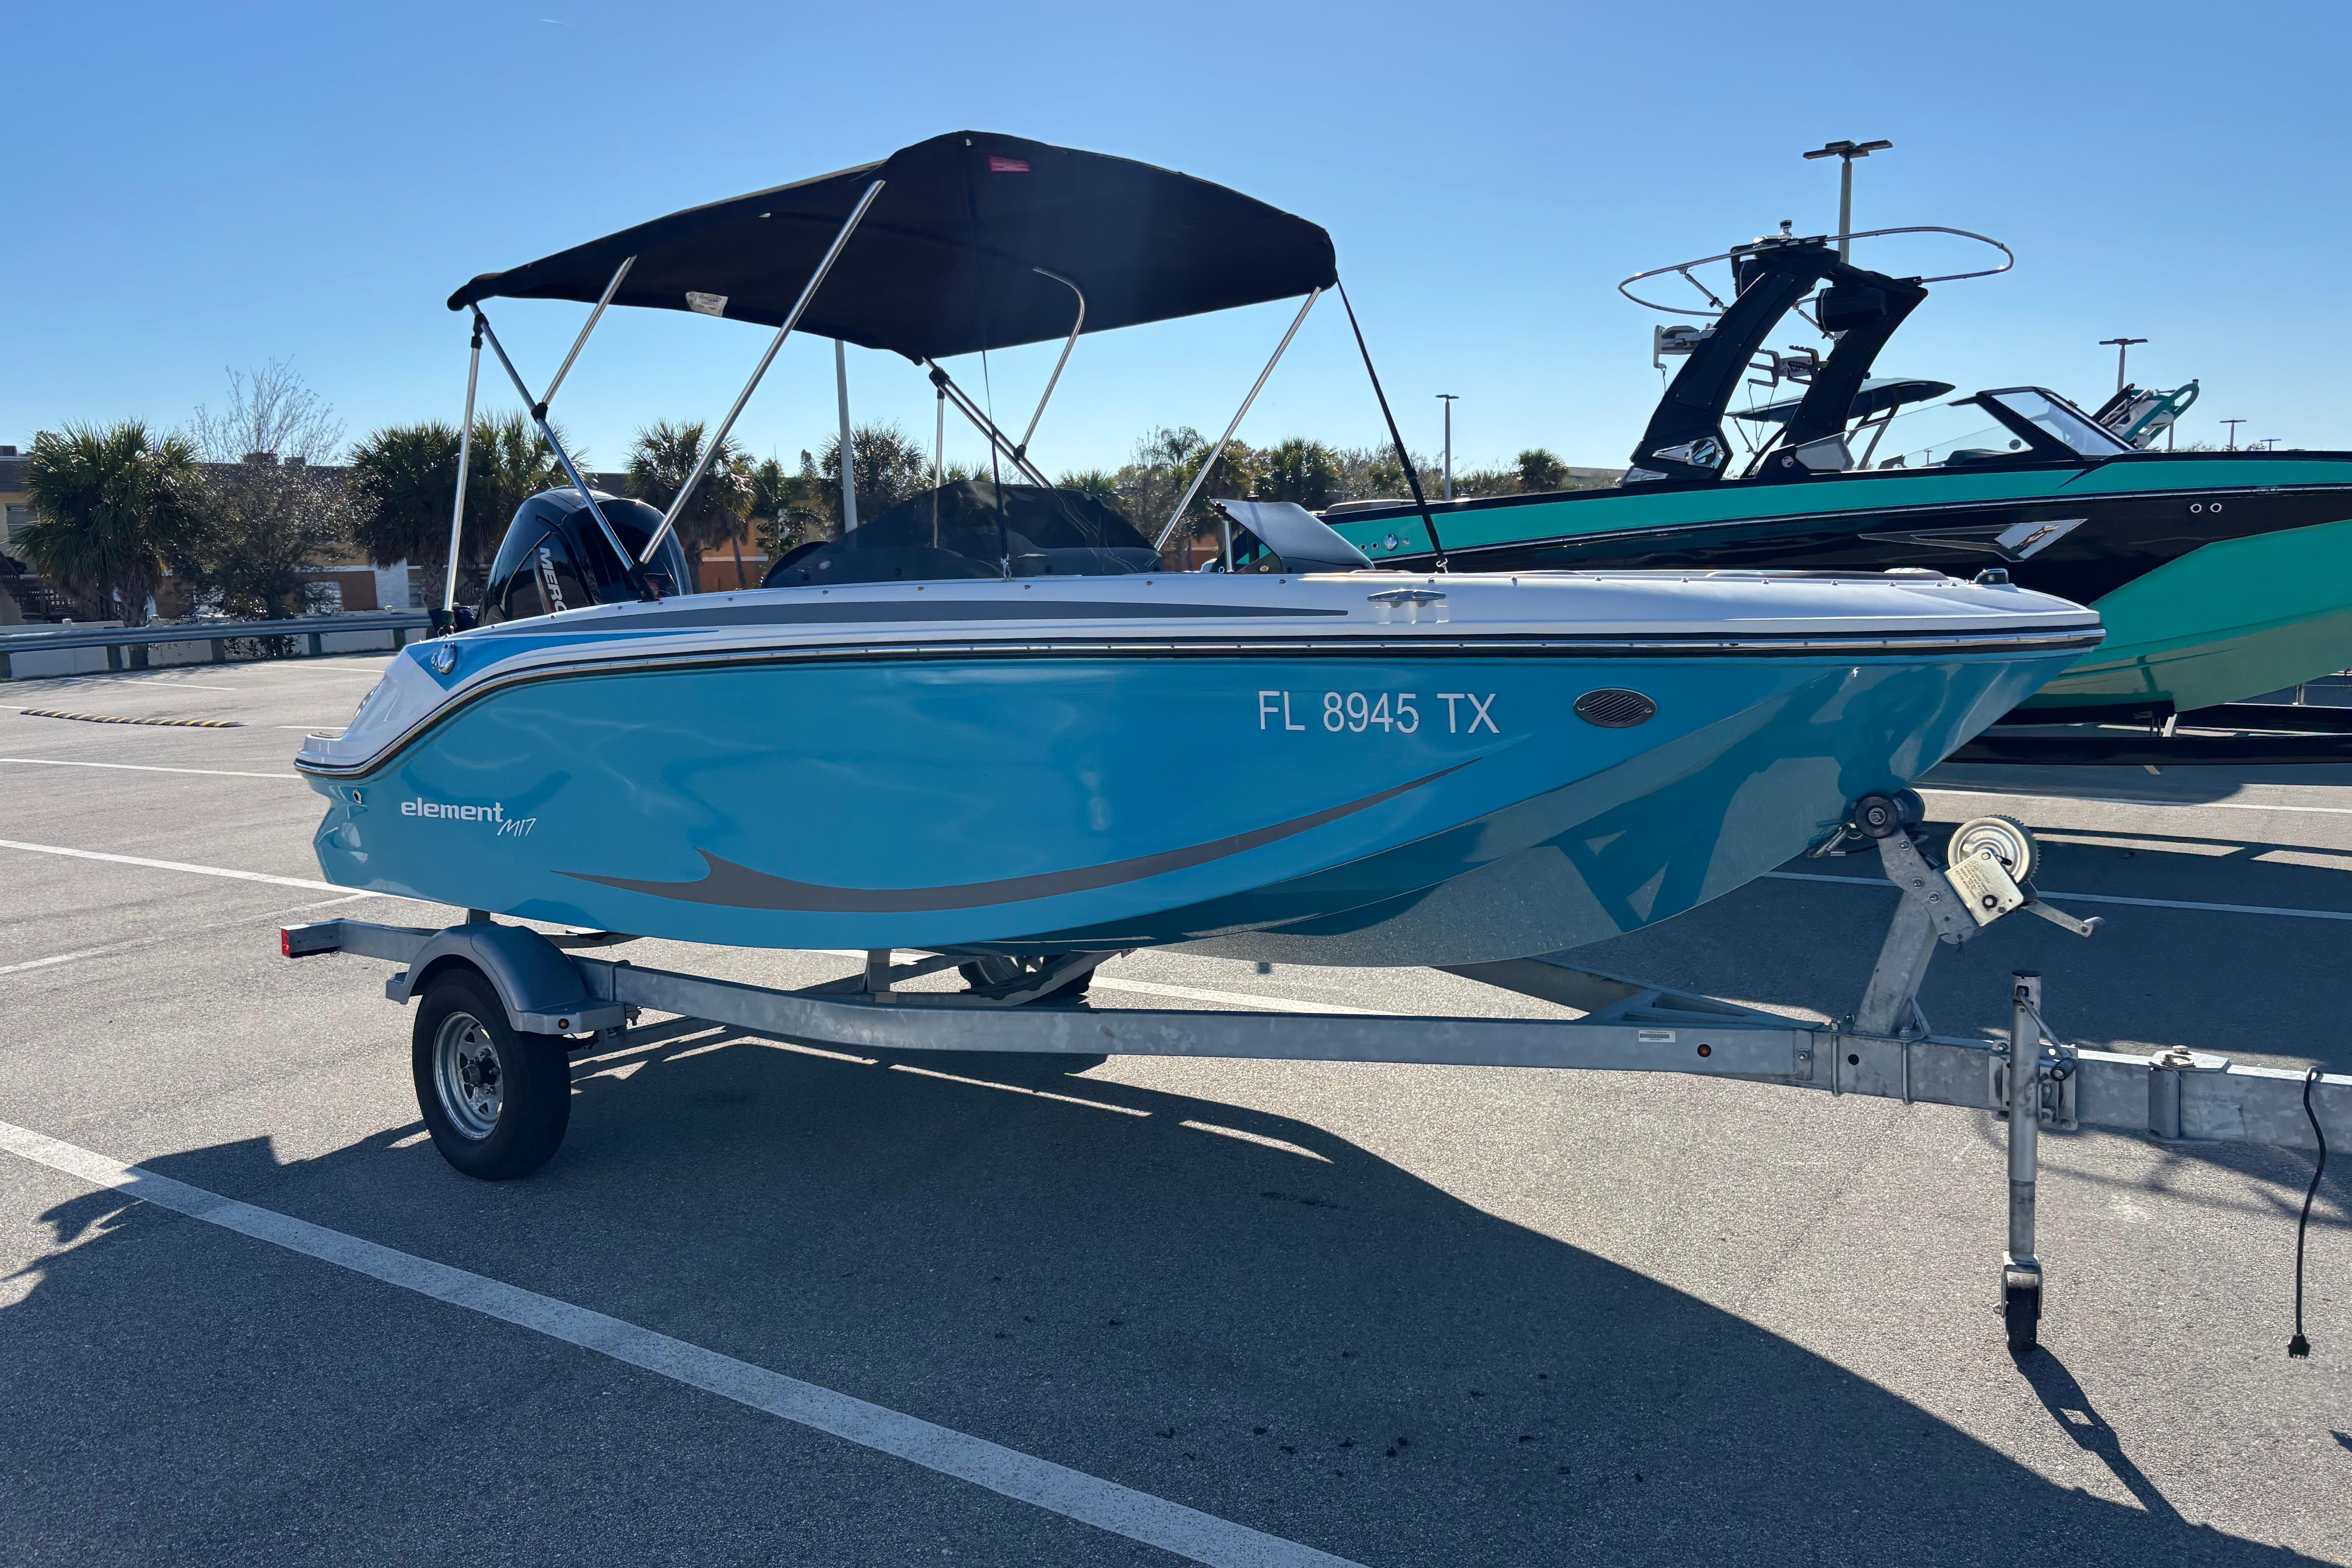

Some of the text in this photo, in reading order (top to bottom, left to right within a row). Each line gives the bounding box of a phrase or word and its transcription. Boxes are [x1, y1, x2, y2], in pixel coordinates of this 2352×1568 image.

[1258, 691, 1500, 733] FL 8945 TX
[401, 798, 504, 822] element
[497, 818, 537, 837] M17
